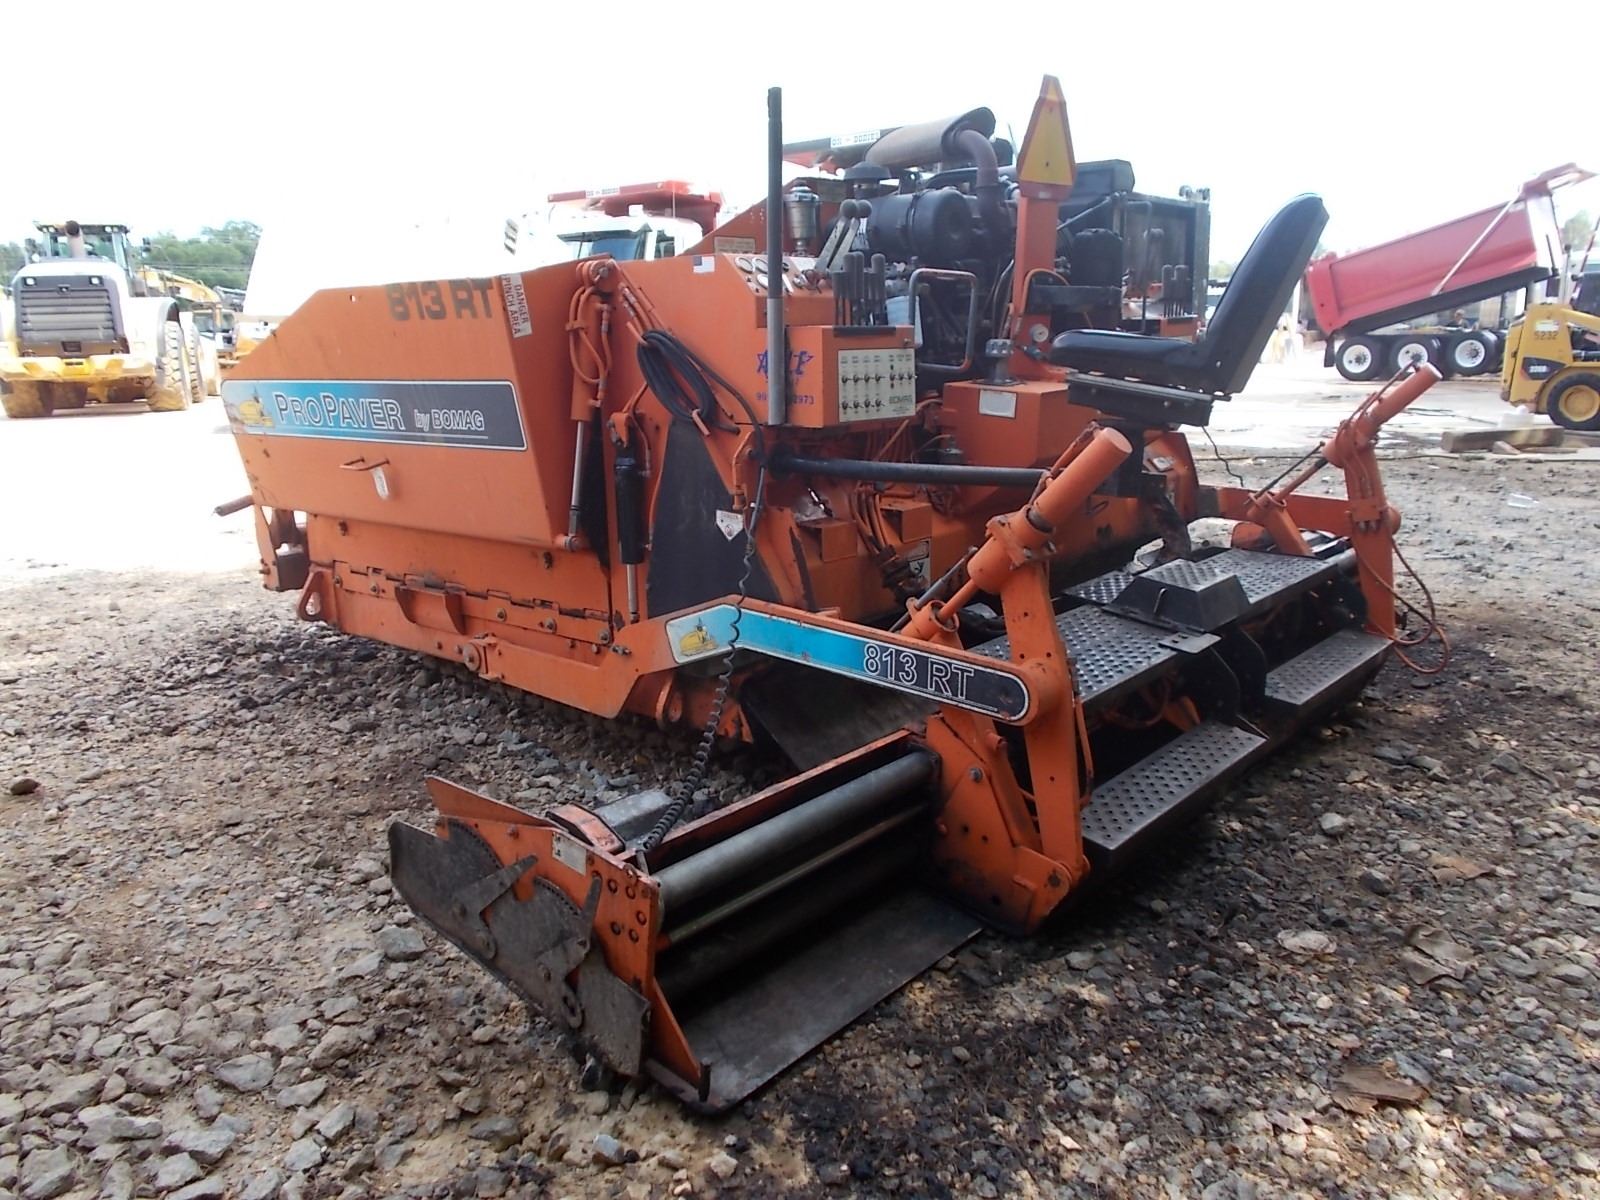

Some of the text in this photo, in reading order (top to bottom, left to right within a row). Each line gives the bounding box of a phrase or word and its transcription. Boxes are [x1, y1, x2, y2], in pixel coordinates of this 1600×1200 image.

[385, 278, 494, 321] 813 RT
[503, 276, 522, 335] PINCH AREA
[514, 284, 529, 324] DANGER
[414, 408, 430, 432] by
[431, 408, 485, 431] BOMAG
[863, 642, 974, 700] 813 RT
